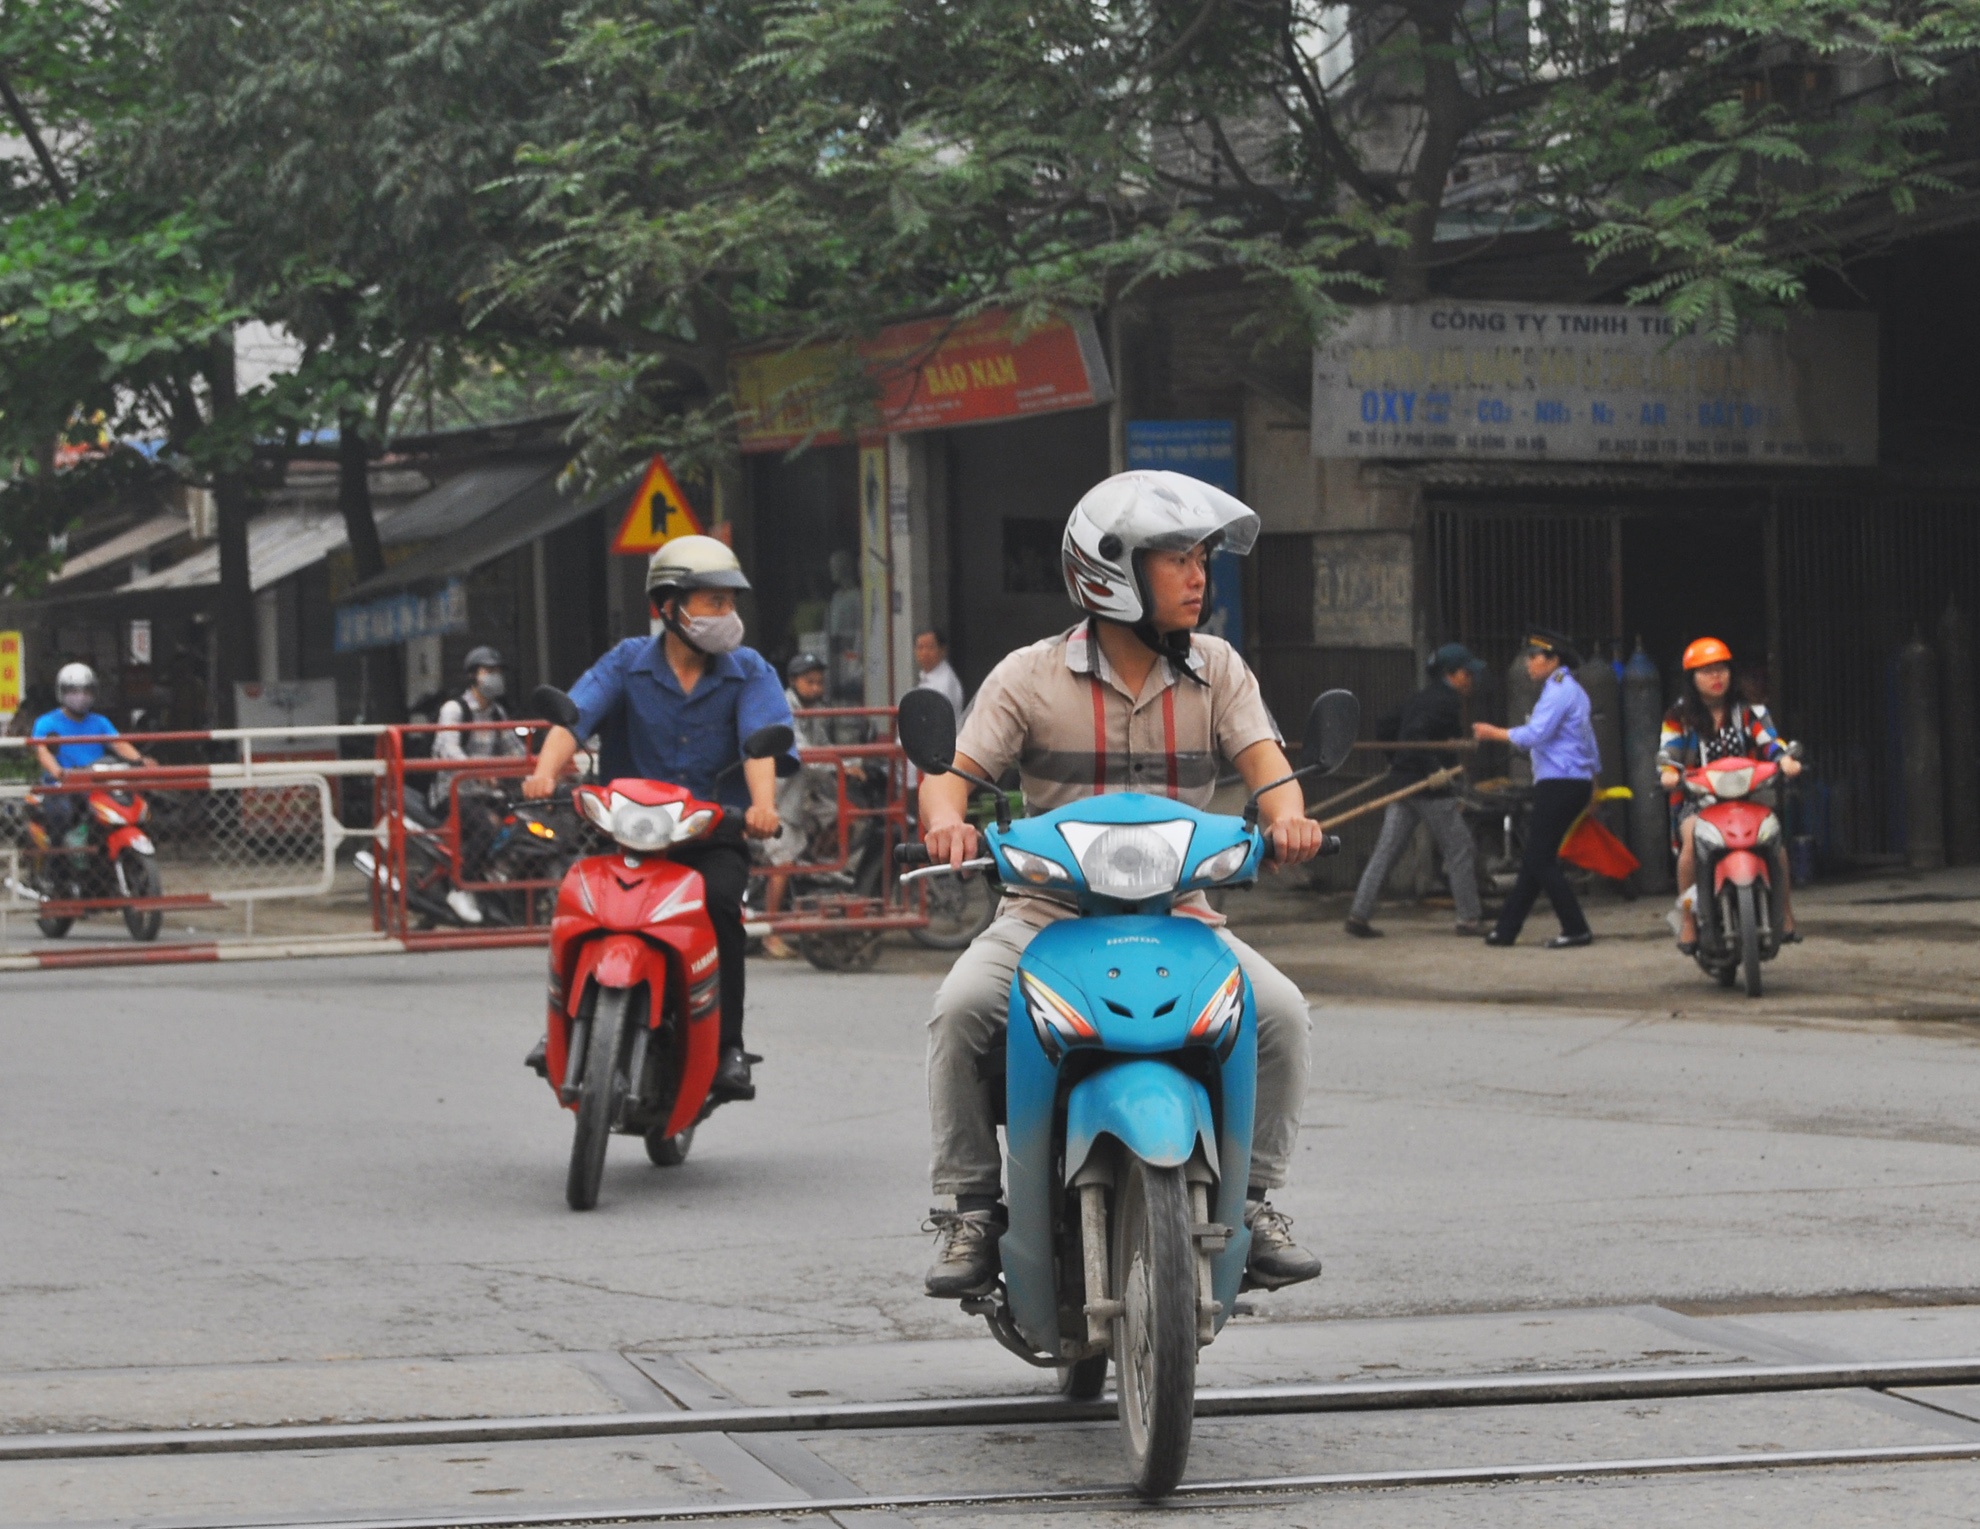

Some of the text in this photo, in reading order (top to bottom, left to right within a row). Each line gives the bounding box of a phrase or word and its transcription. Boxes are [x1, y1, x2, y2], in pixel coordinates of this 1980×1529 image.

[1431, 309, 1505, 331] CÔNG
[1515, 314, 1547, 332] TY
[1557, 315, 1628, 334] TNHH
[968, 356, 1017, 388] NAM
[1361, 390, 1417, 423] OXY
[1107, 936, 1160, 946] HONDA
[691, 945, 718, 974] YAMAH
